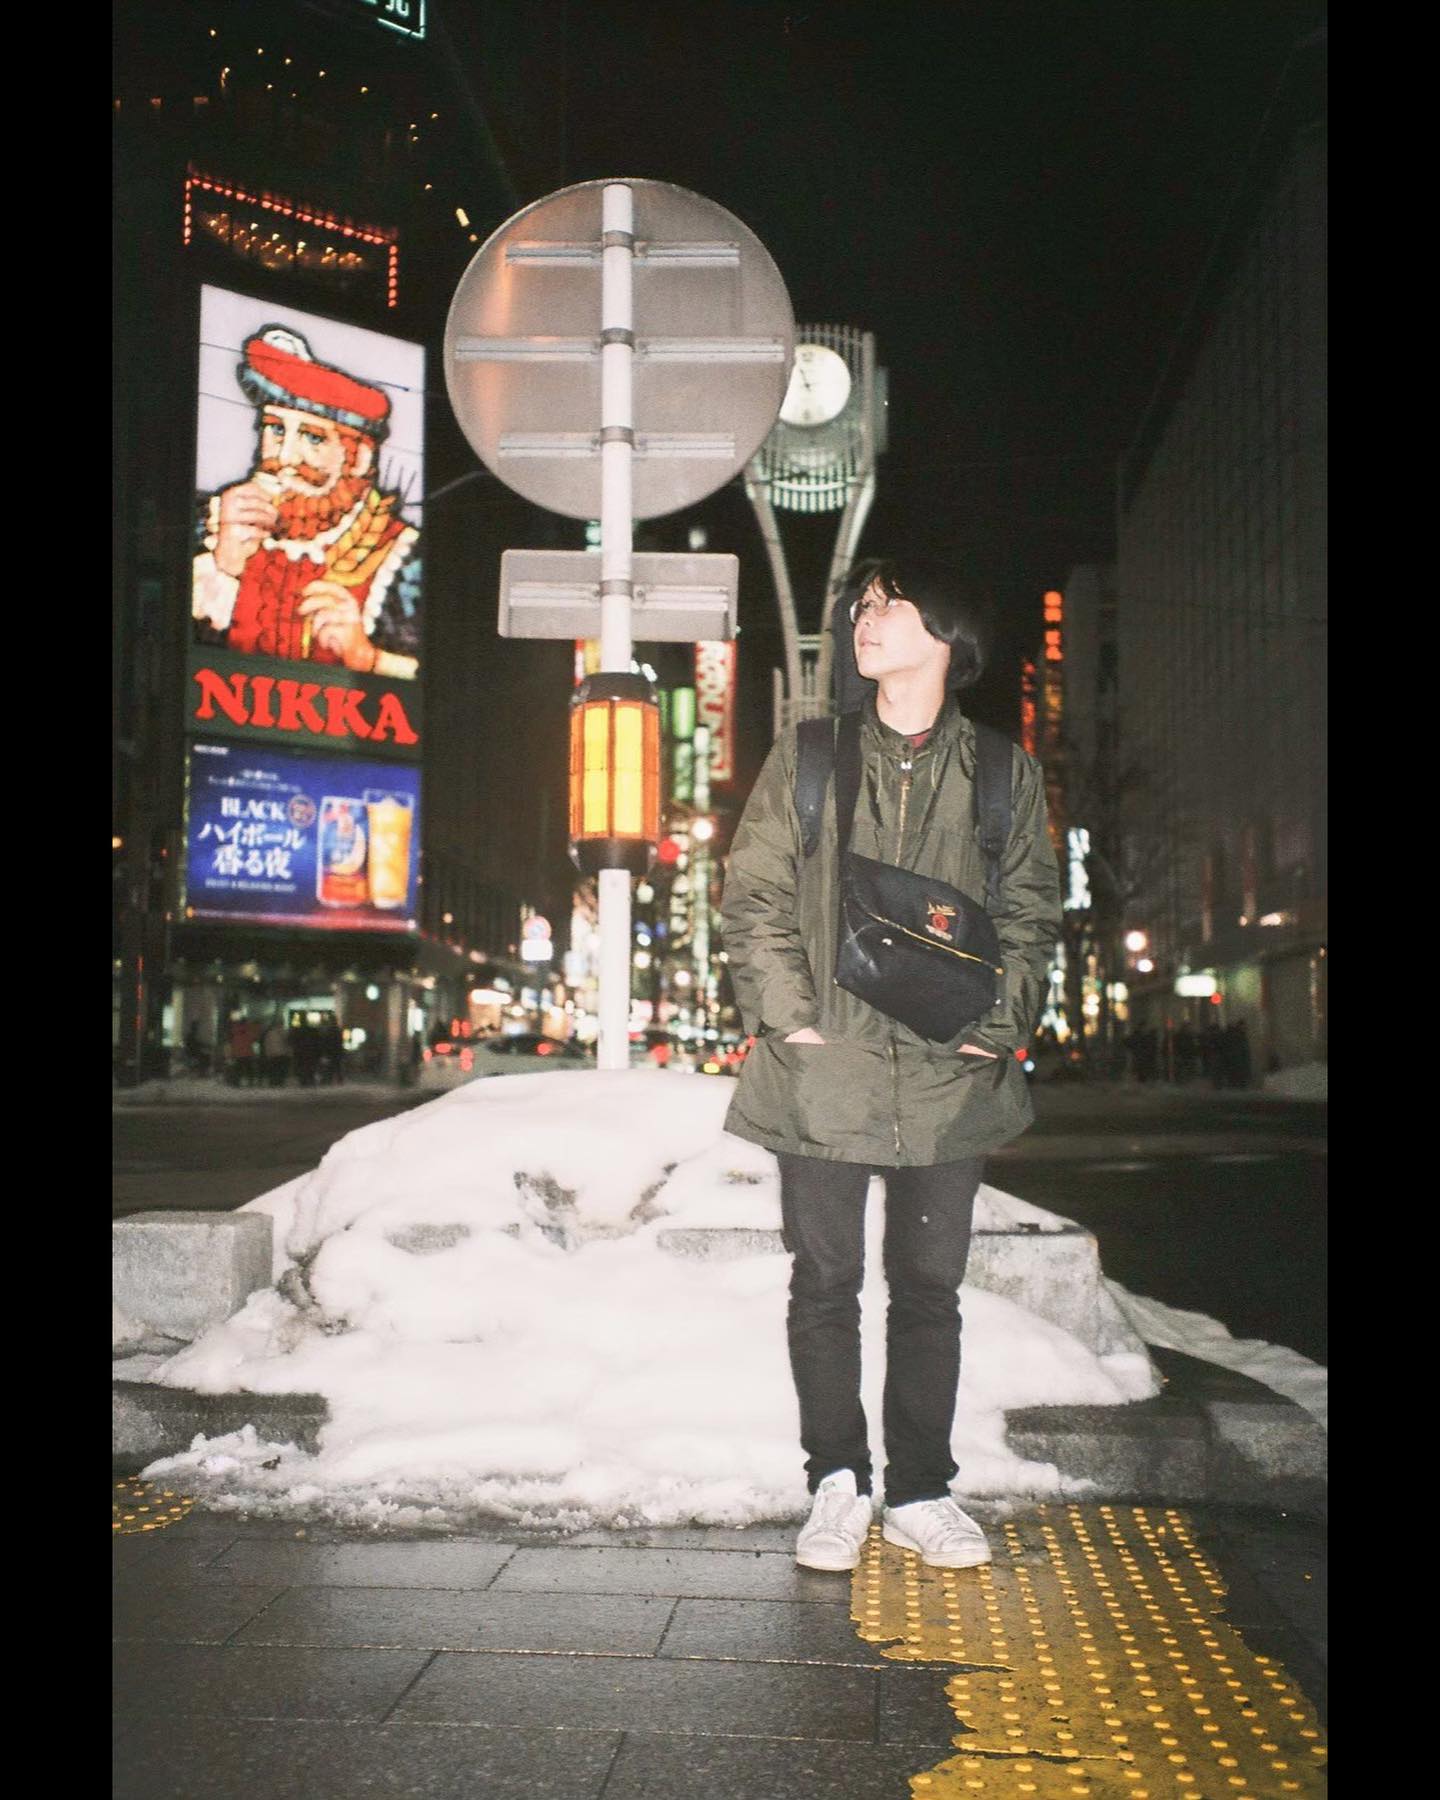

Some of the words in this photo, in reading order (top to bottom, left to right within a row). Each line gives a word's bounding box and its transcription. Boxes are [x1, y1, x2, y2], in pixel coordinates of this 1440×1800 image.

[193, 668, 420, 744] NIKKA
[198, 821, 307, 850] ハイボール
